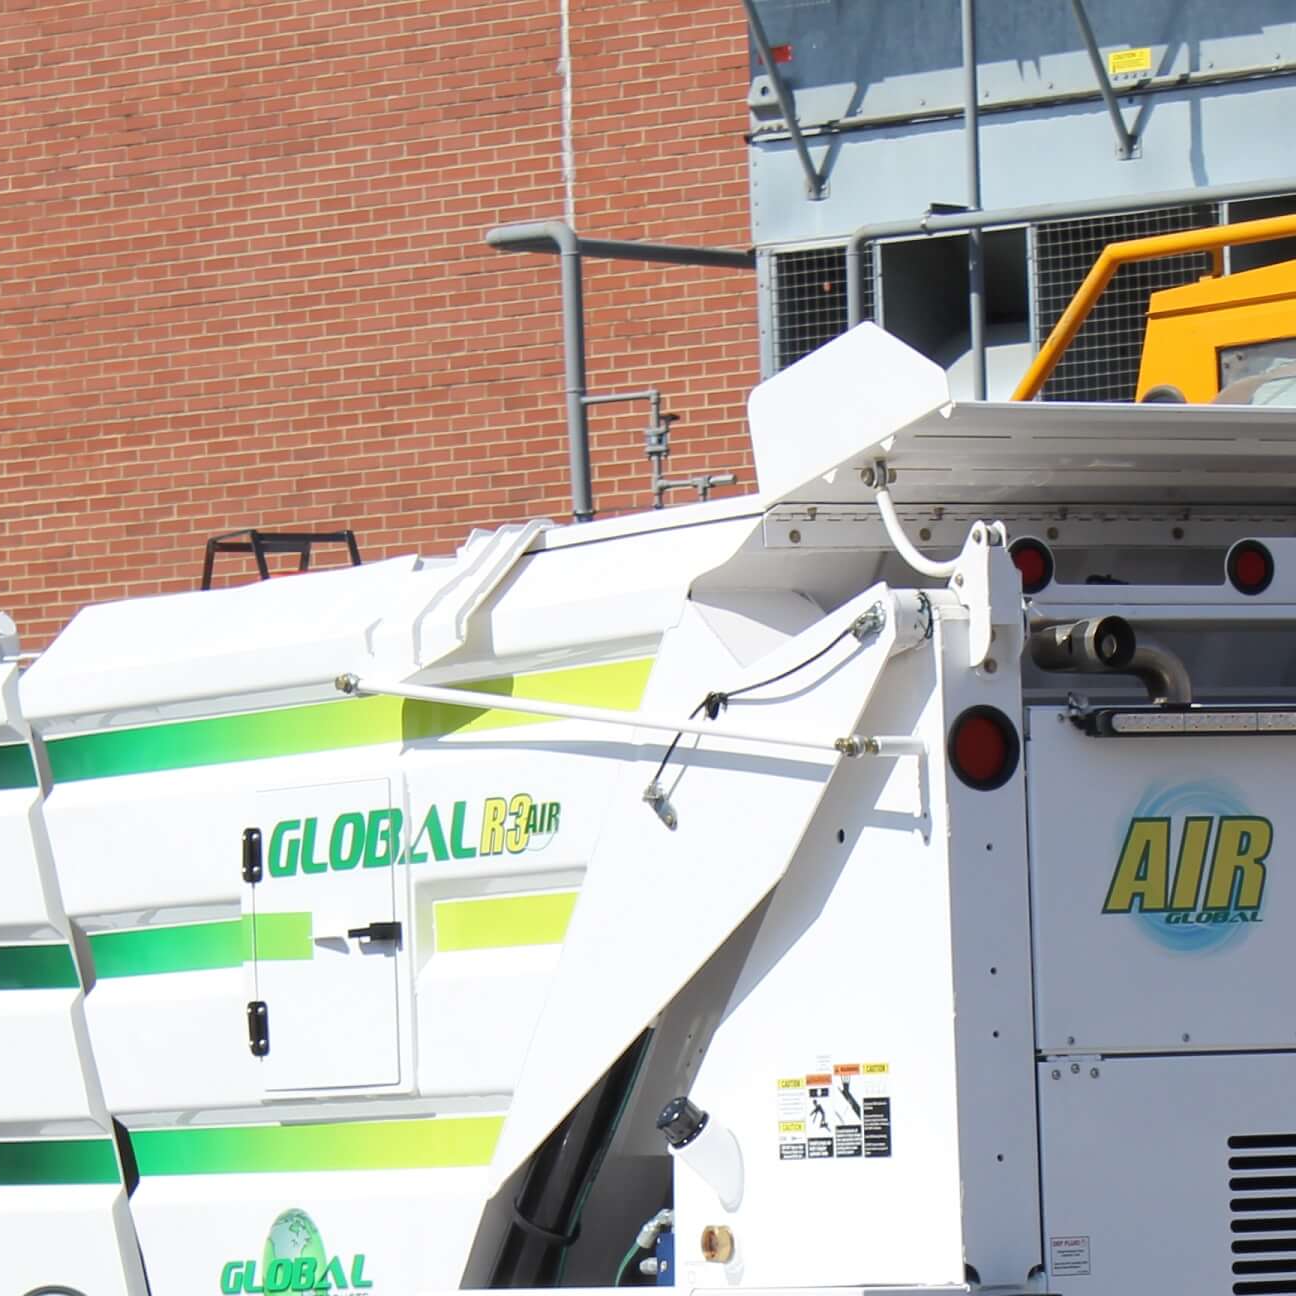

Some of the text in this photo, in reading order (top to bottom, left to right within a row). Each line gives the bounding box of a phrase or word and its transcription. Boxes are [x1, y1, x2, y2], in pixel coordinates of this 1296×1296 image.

[268, 801, 477, 878] GLOBAL
[1102, 816, 1274, 914] AIR
[1165, 911, 1264, 925] GLOBAL
[220, 1253, 374, 1296] GLOBAL
